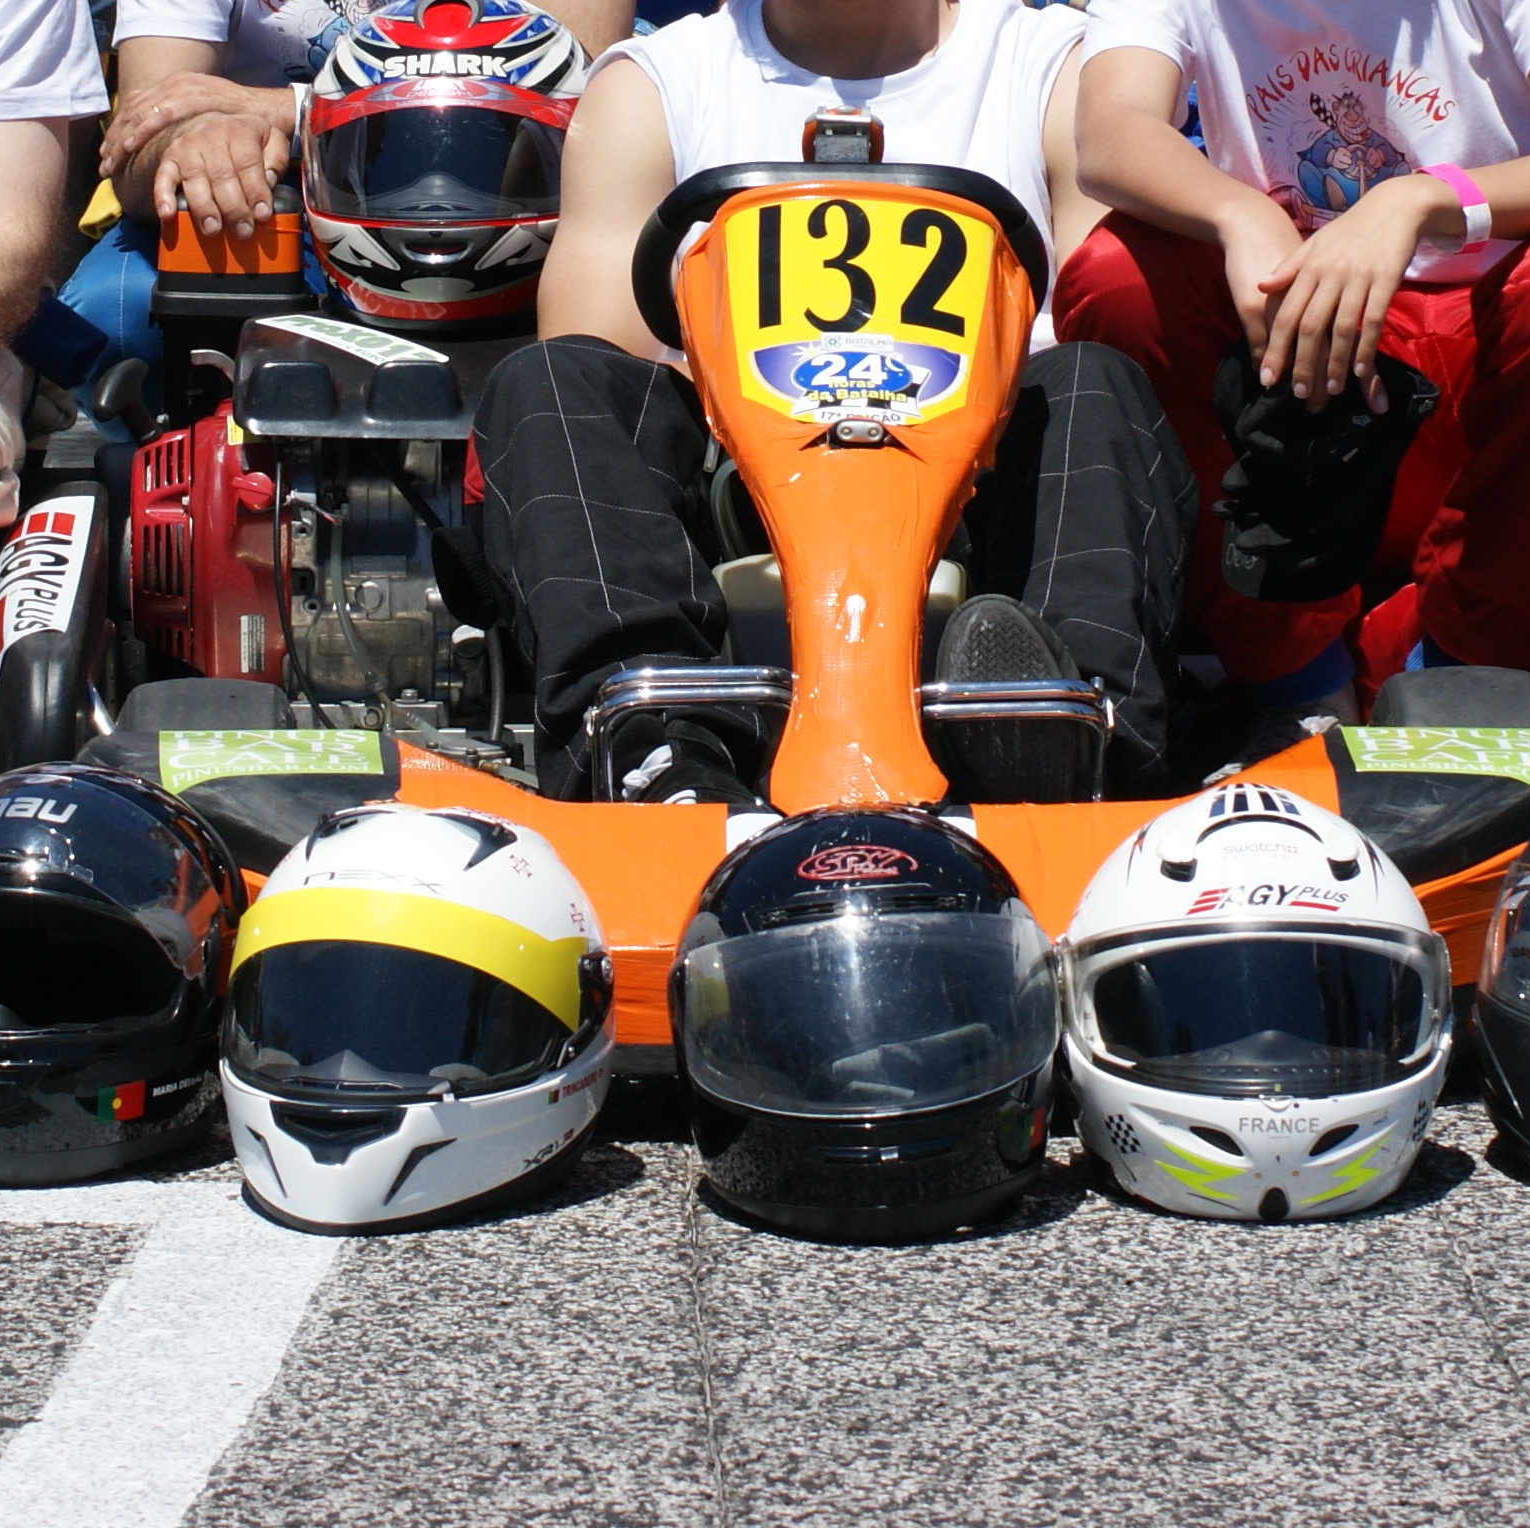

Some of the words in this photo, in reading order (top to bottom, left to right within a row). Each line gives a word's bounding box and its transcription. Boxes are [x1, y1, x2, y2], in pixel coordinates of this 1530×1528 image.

[382, 51, 507, 78] SHARK
[1246, 64, 1295, 122] PAIS
[1290, 43, 1340, 82] DAS
[1345, 46, 1455, 122] CRIANÇAS
[759, 199, 967, 337] 132
[810, 353, 888, 386] 24
[829, 378, 876, 389] horas
[808, 389, 829, 402] da
[836, 389, 907, 402] Batalha
[174, 730, 367, 743] PINUS
[172, 738, 360, 755] BAR
[171, 763, 368, 788] PINUSBAR.COM
[1223, 843, 1286, 855] swatch
[1238, 1117, 1320, 1134] FRANCE
